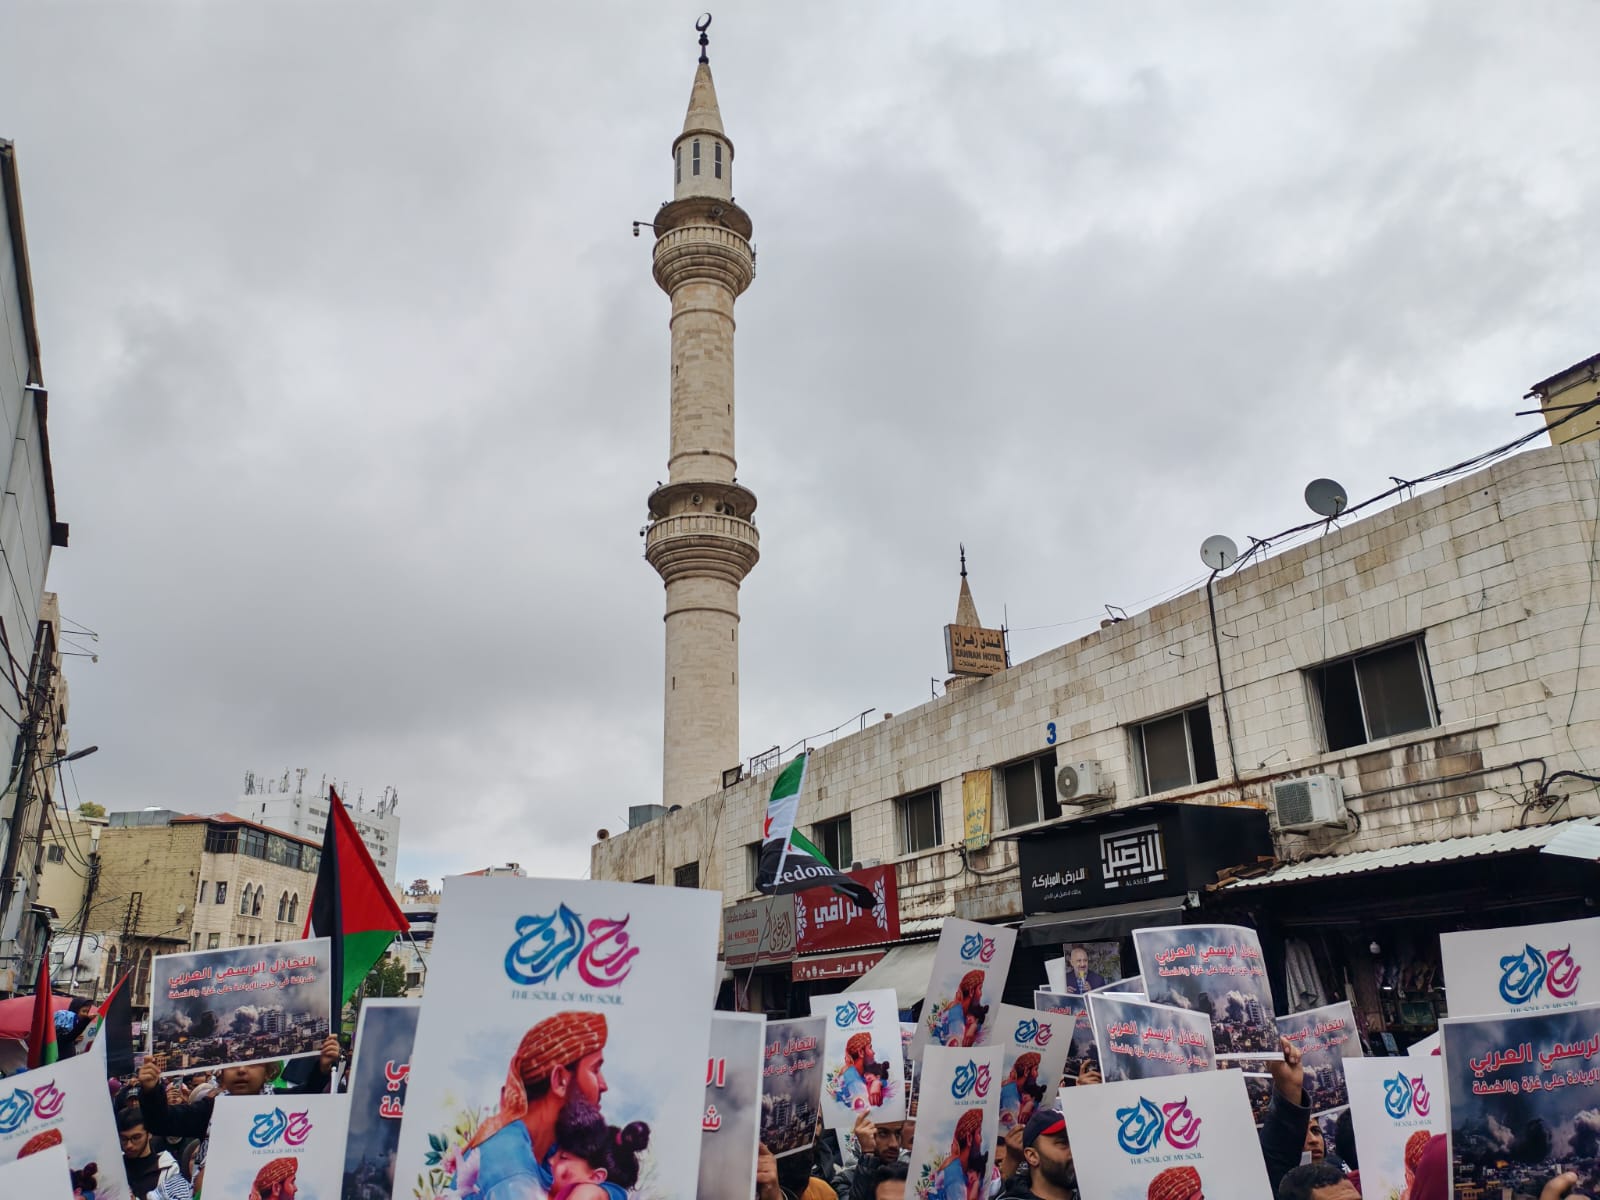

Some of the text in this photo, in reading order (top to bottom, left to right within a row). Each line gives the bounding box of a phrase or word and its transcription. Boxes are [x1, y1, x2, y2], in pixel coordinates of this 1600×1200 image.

[955, 631, 1001, 649] فندق زهران
[983, 651, 1003, 662] HOTEL
[1046, 722, 1057, 745] 3
[1031, 872, 1061, 889] المباركة
[504, 901, 640, 989] روح الروح
[960, 931, 996, 963] روح الروح
[1155, 944, 1195, 965] العربي
[1200, 944, 1237, 962] الرسمي
[168, 967, 211, 989] العربي
[215, 961, 265, 982] الرسمي
[1499, 942, 1581, 1005] روح الروح
[512, 990, 624, 1005] THE SOUL OF MY SOUL
[835, 1000, 875, 1028] روح الروح
[1014, 1018, 1052, 1046] روح الروح
[1106, 1020, 1138, 1039] العربي
[1470, 1033, 1600, 1078] لرسمي العربي
[951, 1059, 991, 1099] روح الروح
[1472, 1078, 1519, 1095] والضفة
[1521, 1075, 1542, 1092] غزة
[1544, 1073, 1565, 1090] على
[33, 1078, 66, 1119] روح
[1383, 1070, 1430, 1119] روح الروح
[248, 1106, 313, 1148] روح الروح
[1116, 1095, 1202, 1155] روح الروح
